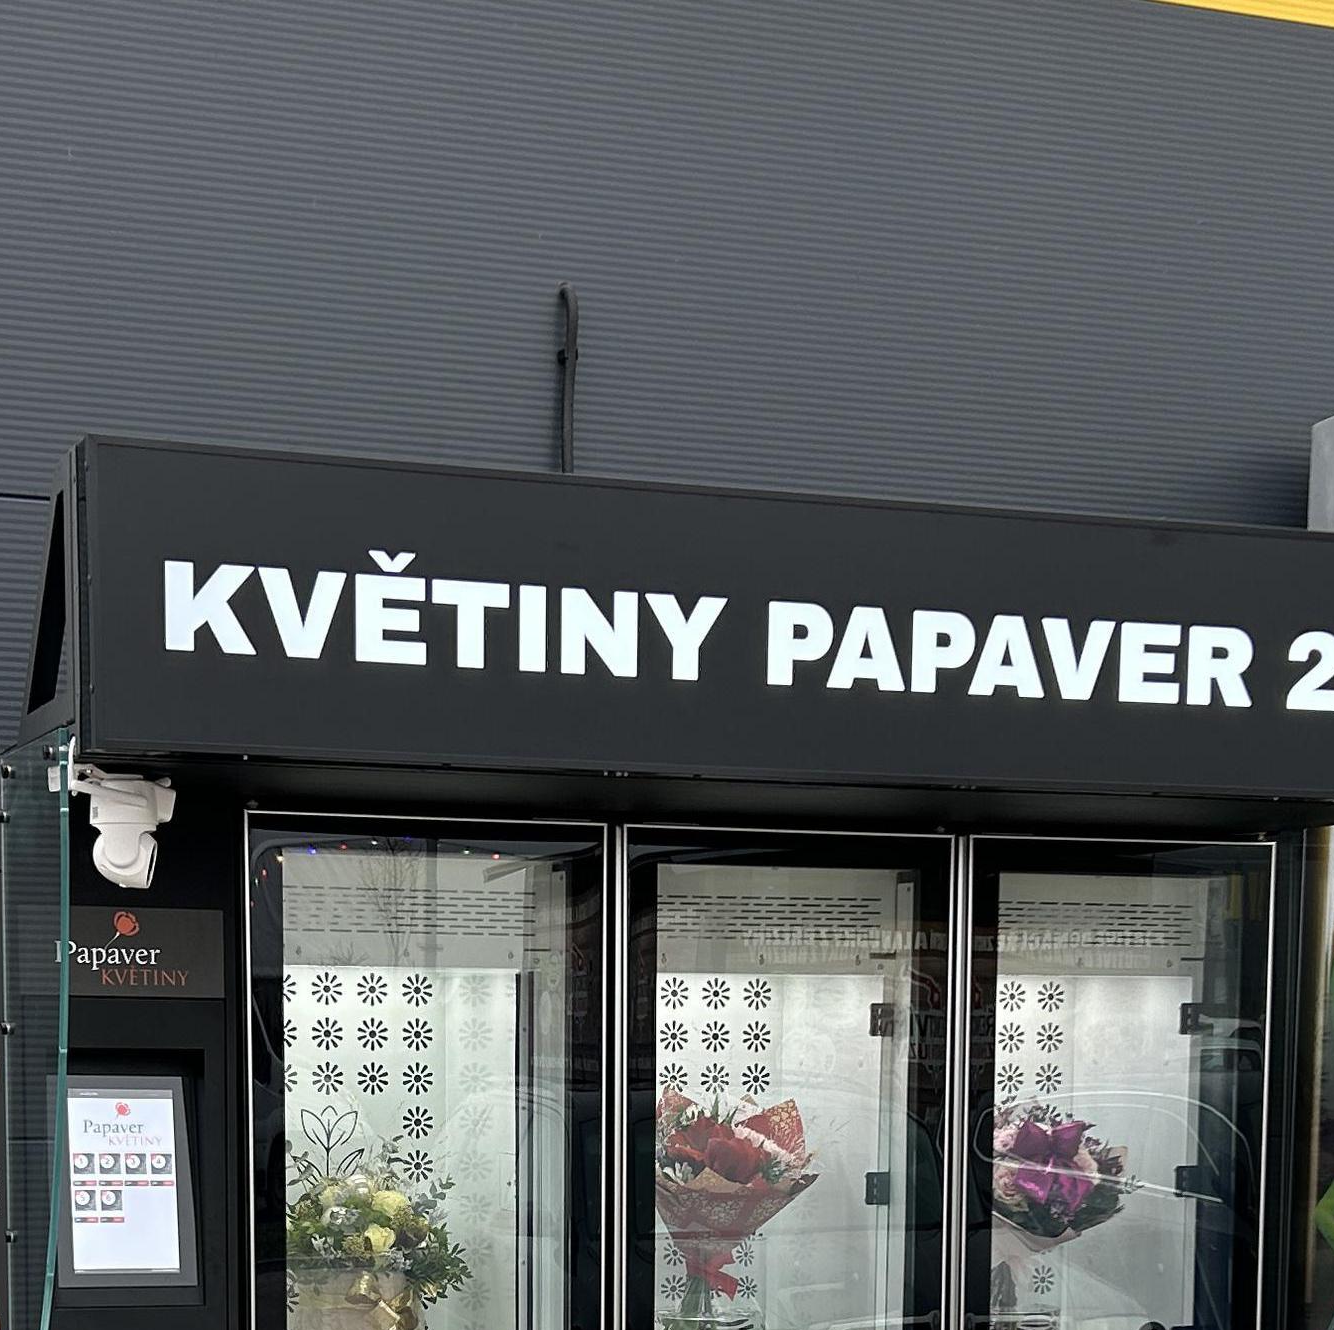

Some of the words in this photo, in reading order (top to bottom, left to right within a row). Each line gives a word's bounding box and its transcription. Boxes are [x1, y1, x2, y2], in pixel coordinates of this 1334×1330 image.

[164, 549, 729, 682] KVĚTINY
[766, 600, 1255, 709] PAPAVER
[54, 940, 161, 971] Papaver
[101, 964, 189, 987] KVĚTINY
[83, 1119, 144, 1137] Papaver
